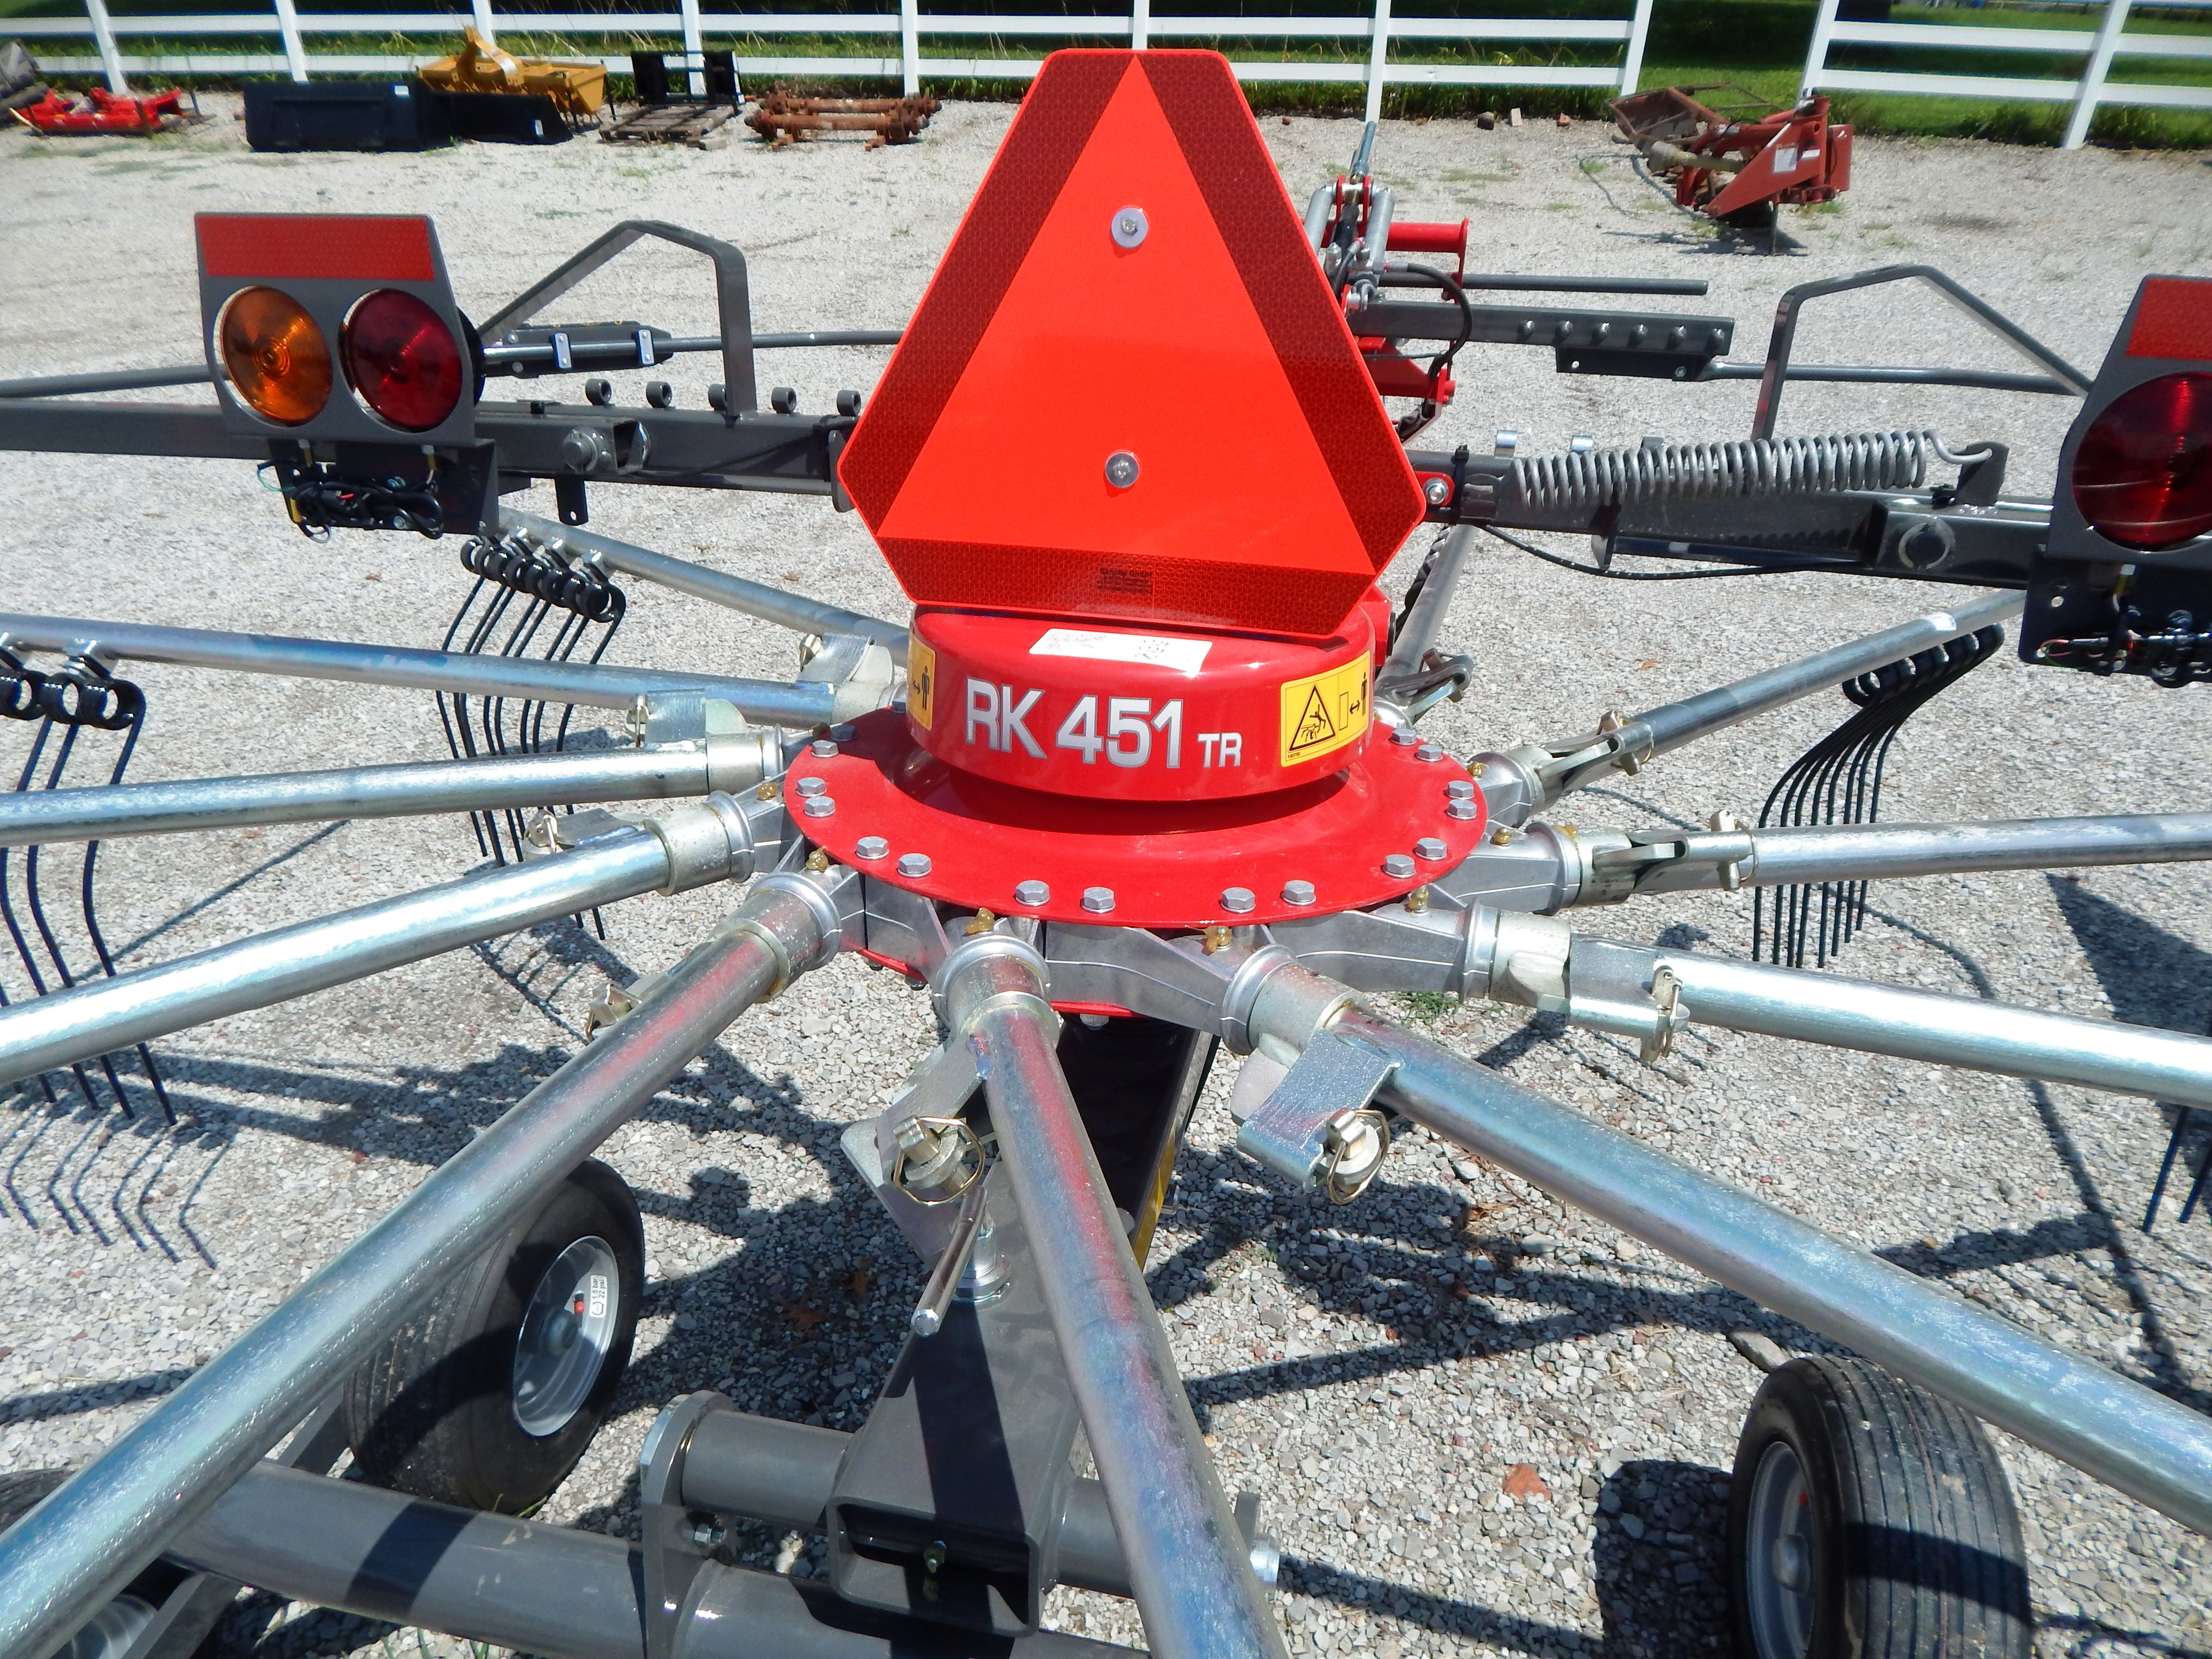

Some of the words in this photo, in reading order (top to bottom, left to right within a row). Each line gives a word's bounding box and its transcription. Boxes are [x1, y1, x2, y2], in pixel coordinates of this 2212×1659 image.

[966, 676, 1047, 759] RK
[1056, 695, 1184, 769] 451
[1197, 733, 1242, 768] TR
[599, 1290, 605, 1298] 22
